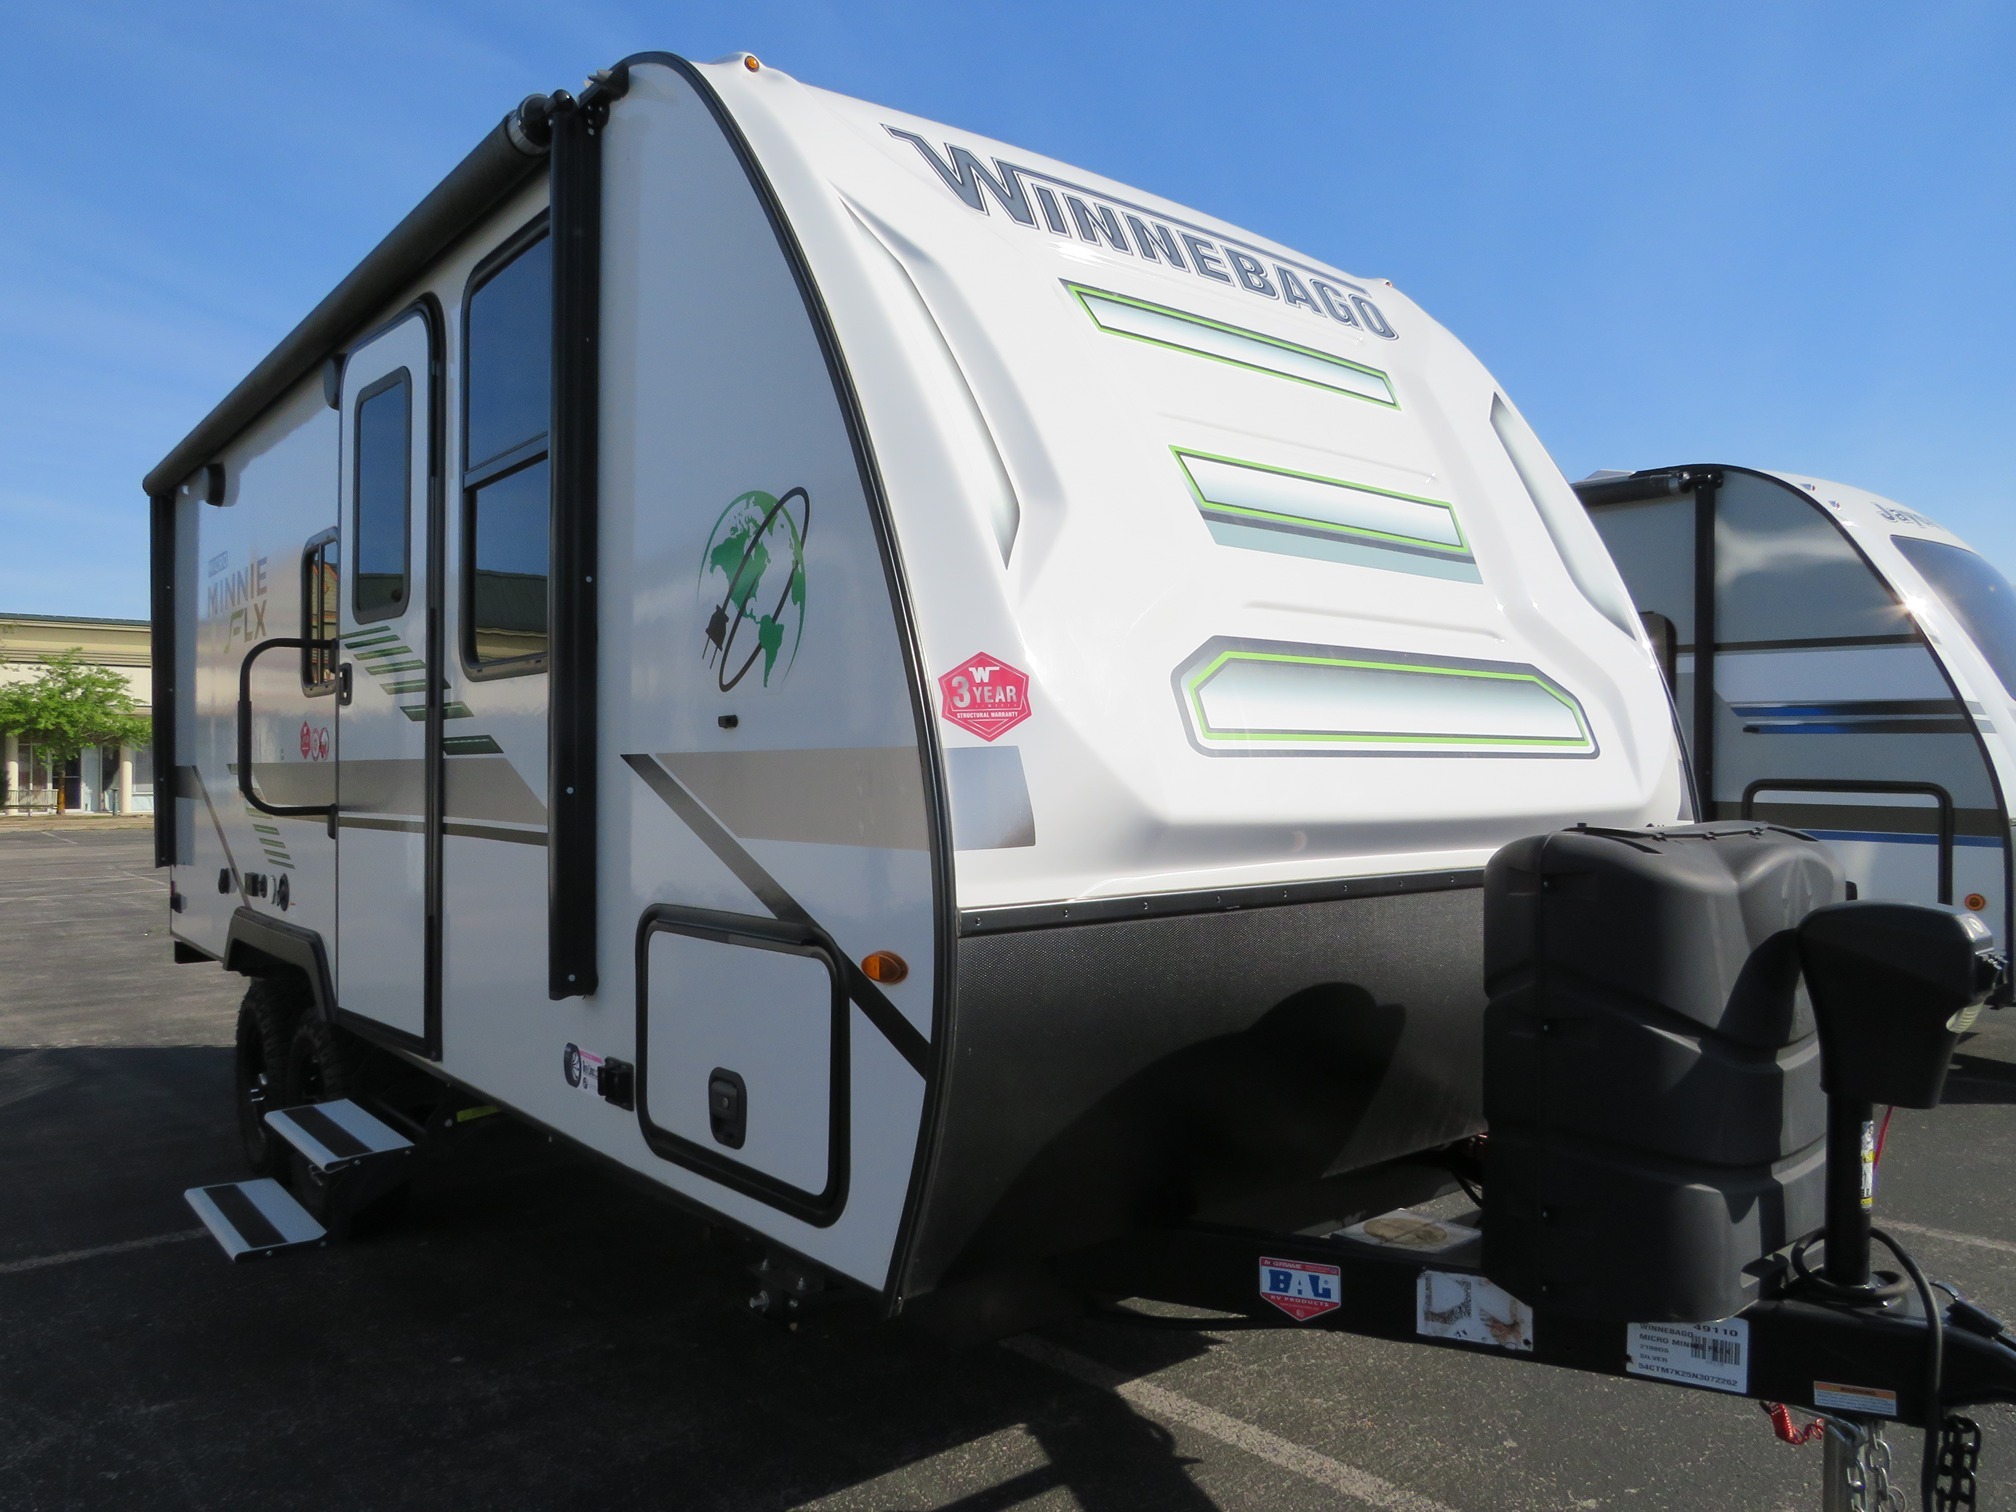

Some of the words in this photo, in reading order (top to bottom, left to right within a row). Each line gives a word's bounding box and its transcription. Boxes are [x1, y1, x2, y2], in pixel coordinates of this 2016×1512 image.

[879, 122, 1399, 341] WINNEBAGO
[207, 556, 268, 618] MINNIE
[224, 599, 267, 654] FLX
[951, 675, 971, 708] 3
[972, 685, 1018, 703] YEAR
[956, 711, 990, 719] STRUCTURAL
[1268, 1269, 1332, 1299] BAL
[1284, 1297, 1329, 1307] PRODUCTS
[1639, 1333, 1669, 1344] MICRO
[1640, 1323, 1694, 1338] WINNEBAGO
[1693, 1323, 1738, 1337] 49110
[1638, 1362, 1738, 1387] 54CTM7K25N3072262
